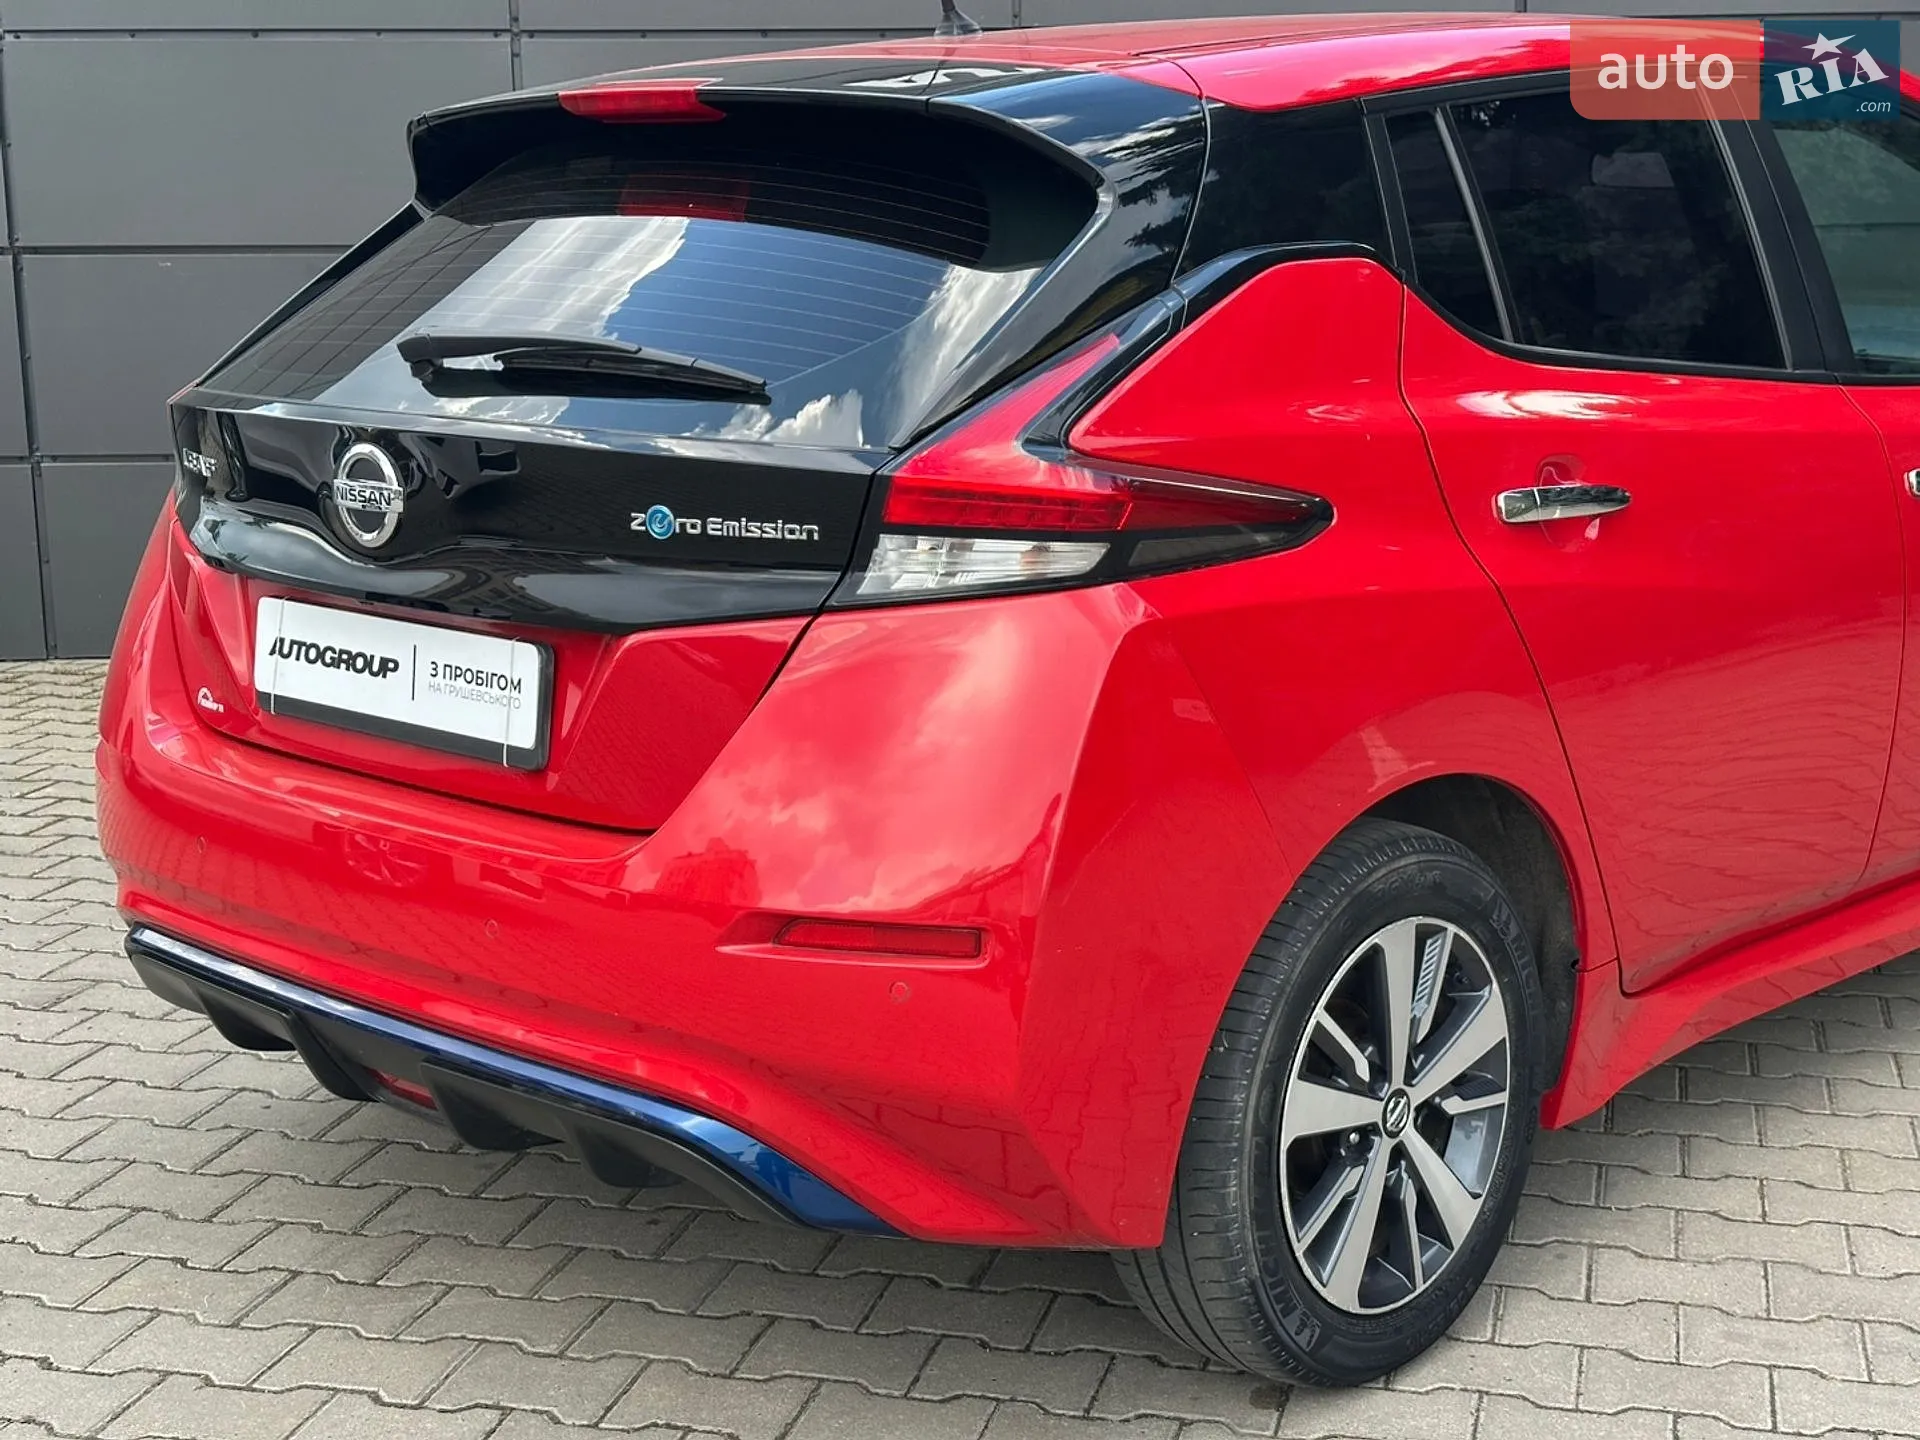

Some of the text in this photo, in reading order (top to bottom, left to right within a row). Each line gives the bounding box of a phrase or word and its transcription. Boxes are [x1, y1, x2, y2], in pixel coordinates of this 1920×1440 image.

[335, 486, 392, 507] NISSAN
[706, 517, 819, 541] Emission
[268, 636, 400, 679] AUTOGROUP
[427, 681, 442, 694] НА
[442, 664, 522, 694] ПРОБІГОМ
